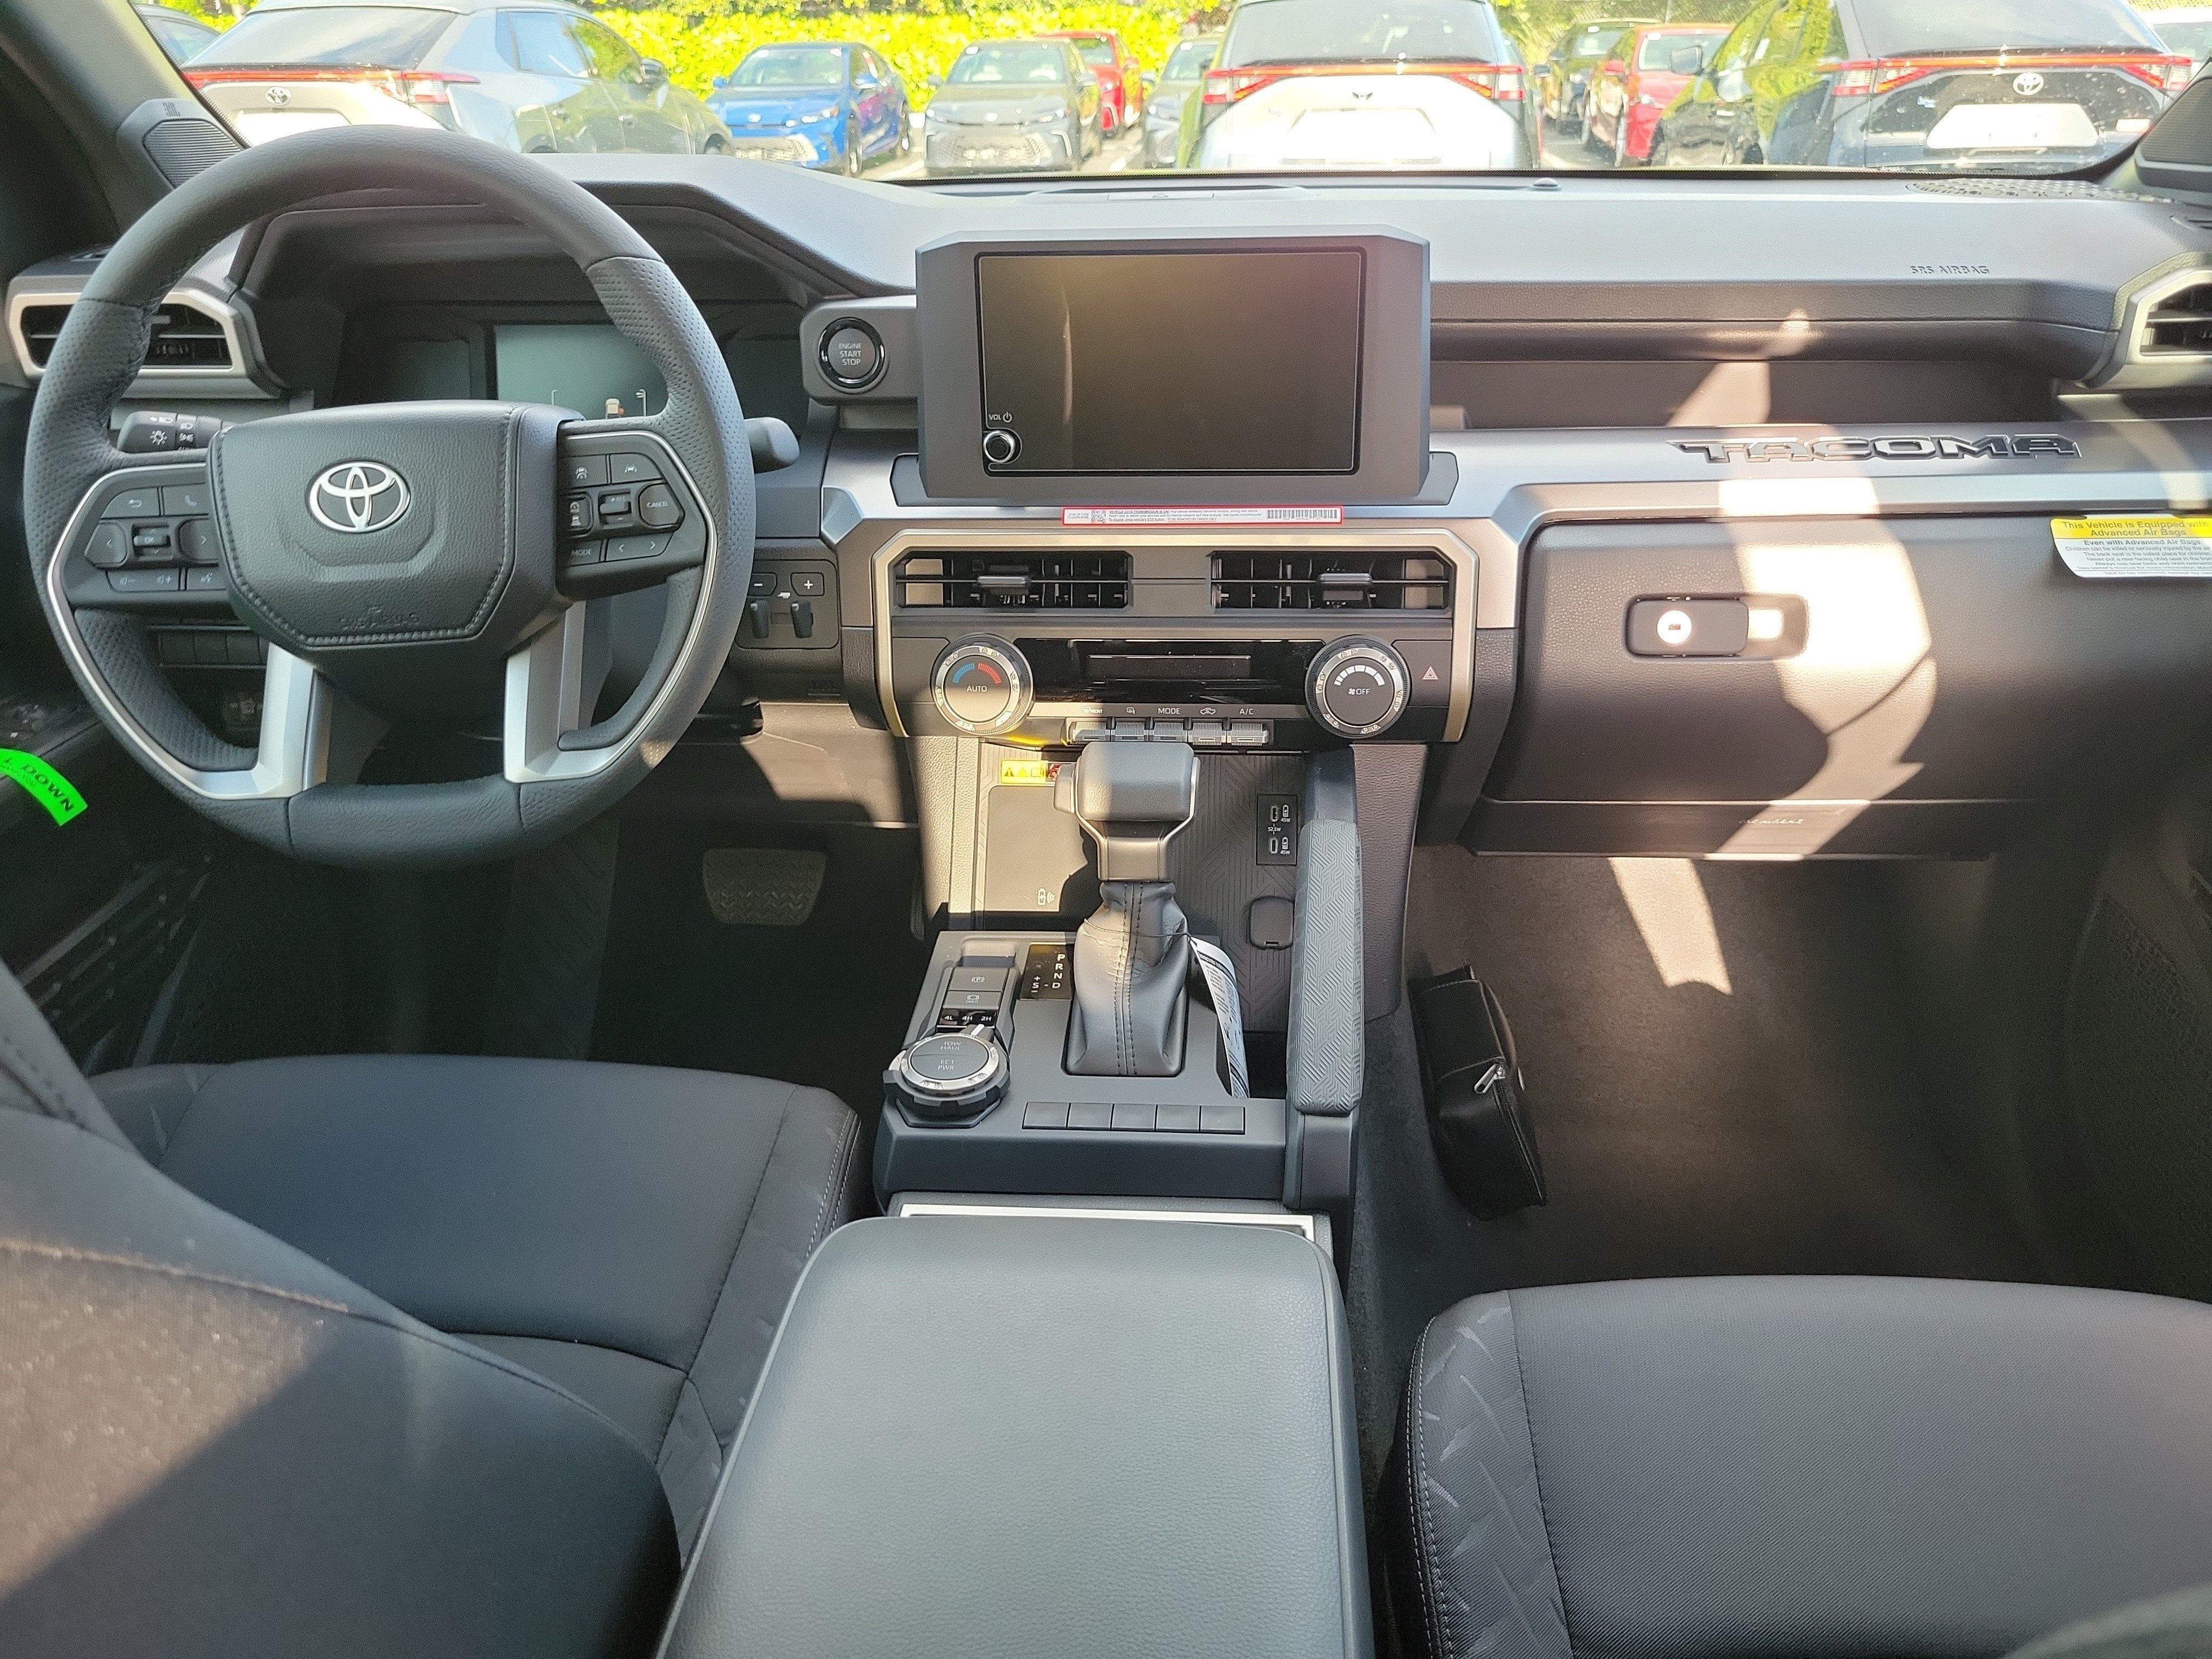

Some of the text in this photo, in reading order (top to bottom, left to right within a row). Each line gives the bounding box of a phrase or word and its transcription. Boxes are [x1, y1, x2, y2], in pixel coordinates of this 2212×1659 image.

[1910, 266, 1990, 274] SRS AIRBAG
[1666, 433, 2083, 464] TACOMA
[2136, 521, 2185, 529] Equipped
[22, 764, 75, 812] DOWN
